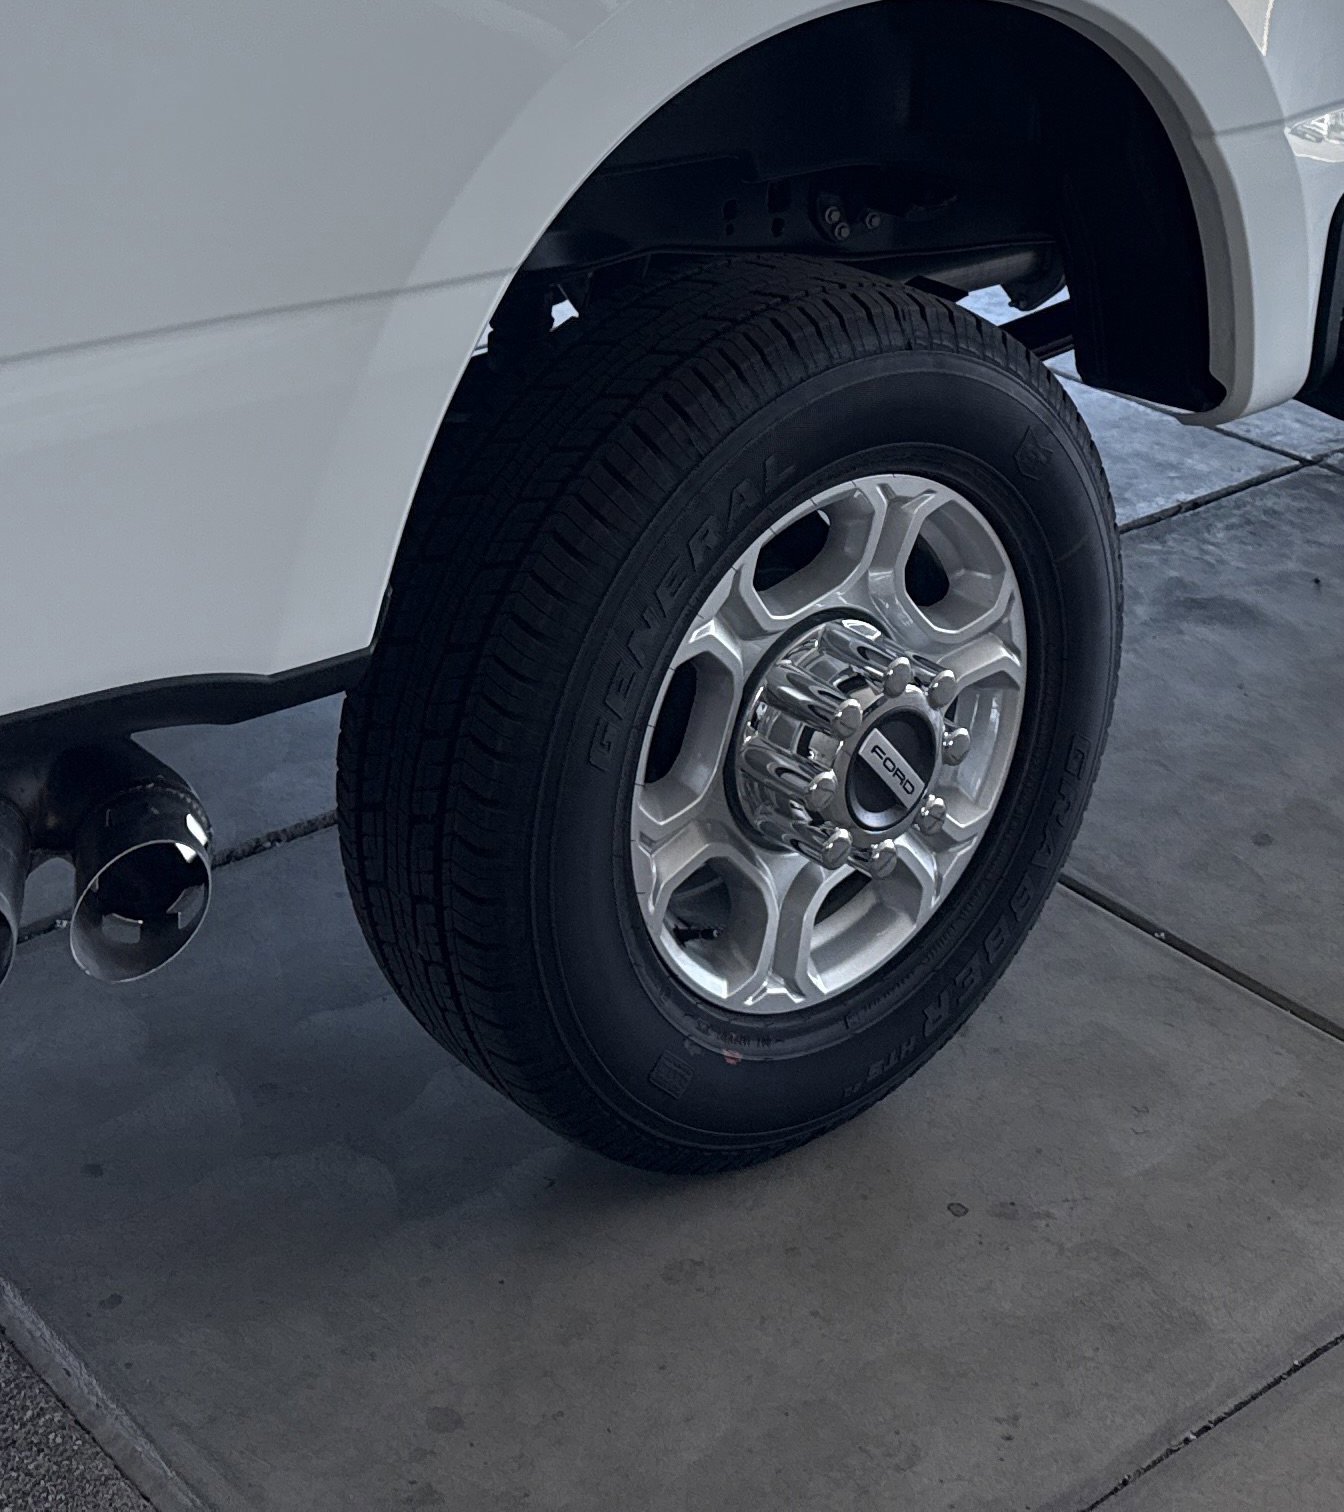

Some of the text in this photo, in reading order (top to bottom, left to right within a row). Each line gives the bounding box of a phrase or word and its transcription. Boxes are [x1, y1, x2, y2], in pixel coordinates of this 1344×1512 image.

[587, 453, 796, 773] GENERAL
[870, 744, 915, 795] FORD
[922, 734, 1092, 1039] GRABBER
